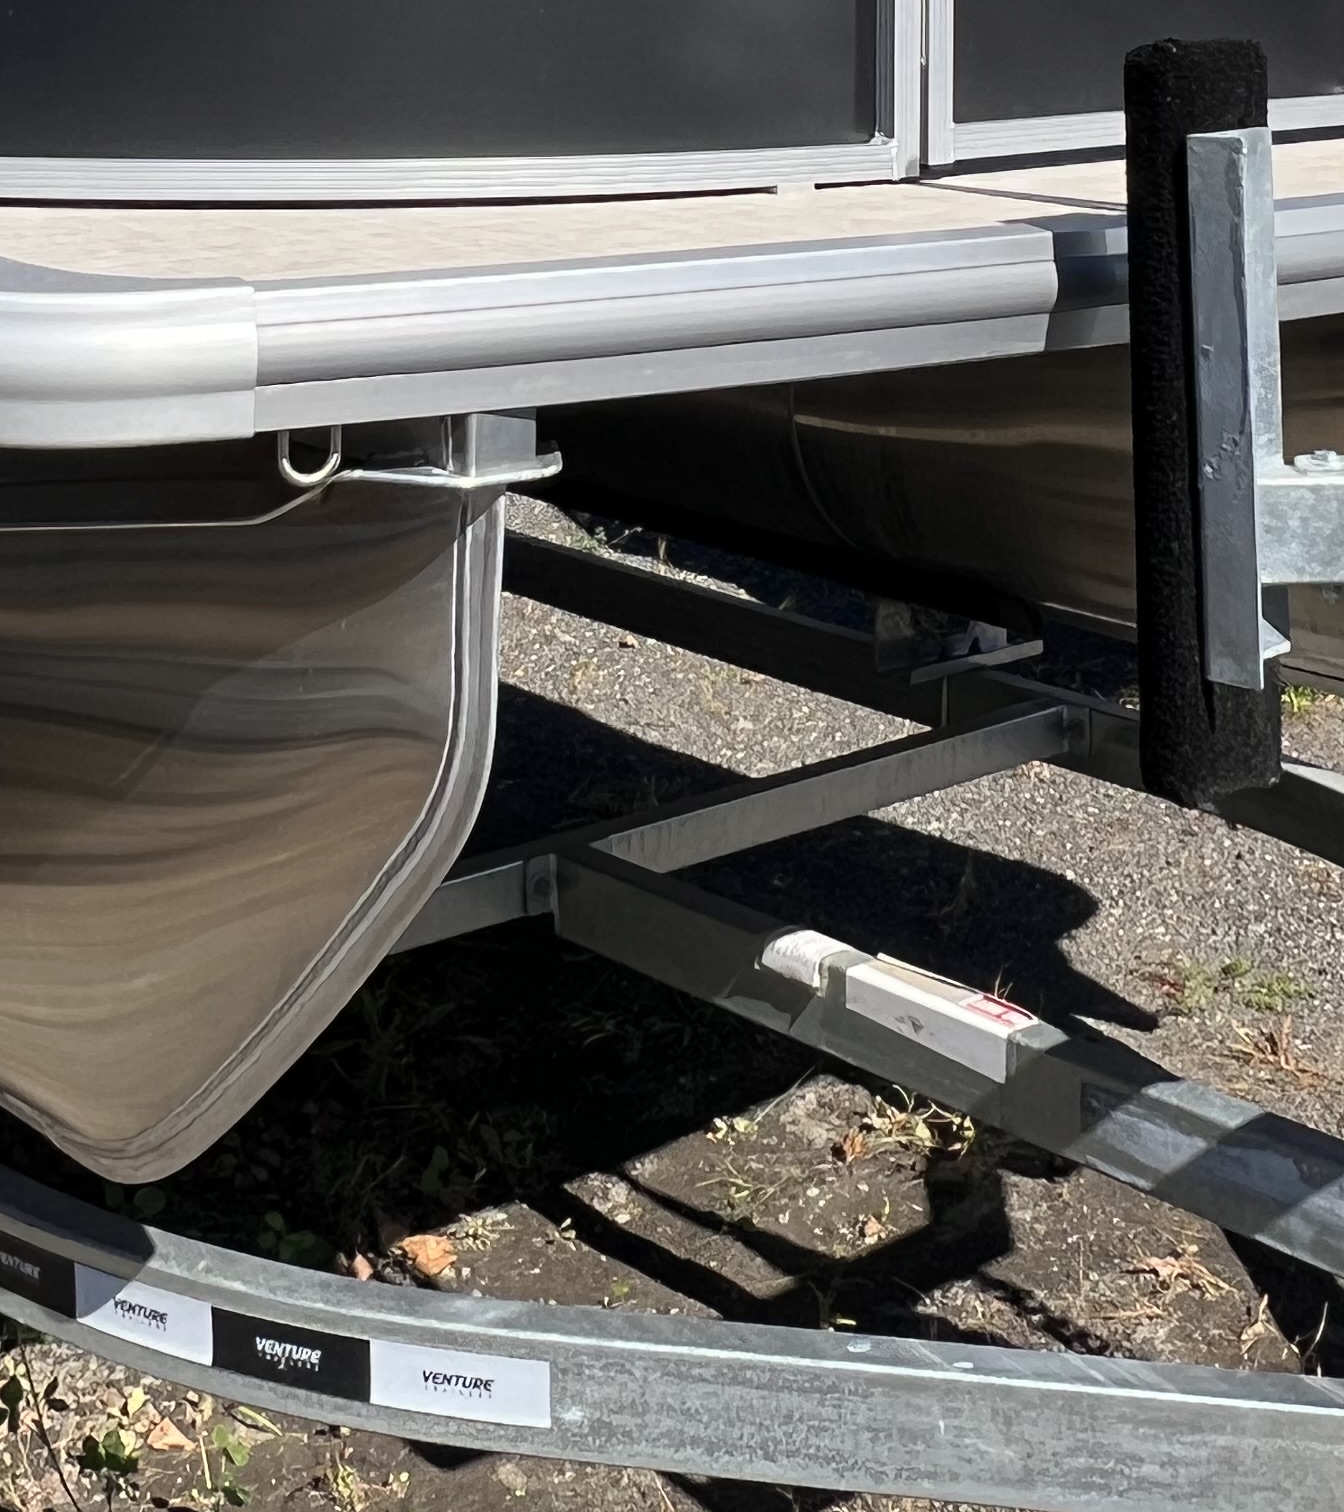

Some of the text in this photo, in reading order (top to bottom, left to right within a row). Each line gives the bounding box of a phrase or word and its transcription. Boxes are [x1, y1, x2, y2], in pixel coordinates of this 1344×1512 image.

[113, 1296, 168, 1325] VENTURE
[255, 1336, 322, 1364] VENTURE
[422, 1369, 495, 1392] VENTURE
